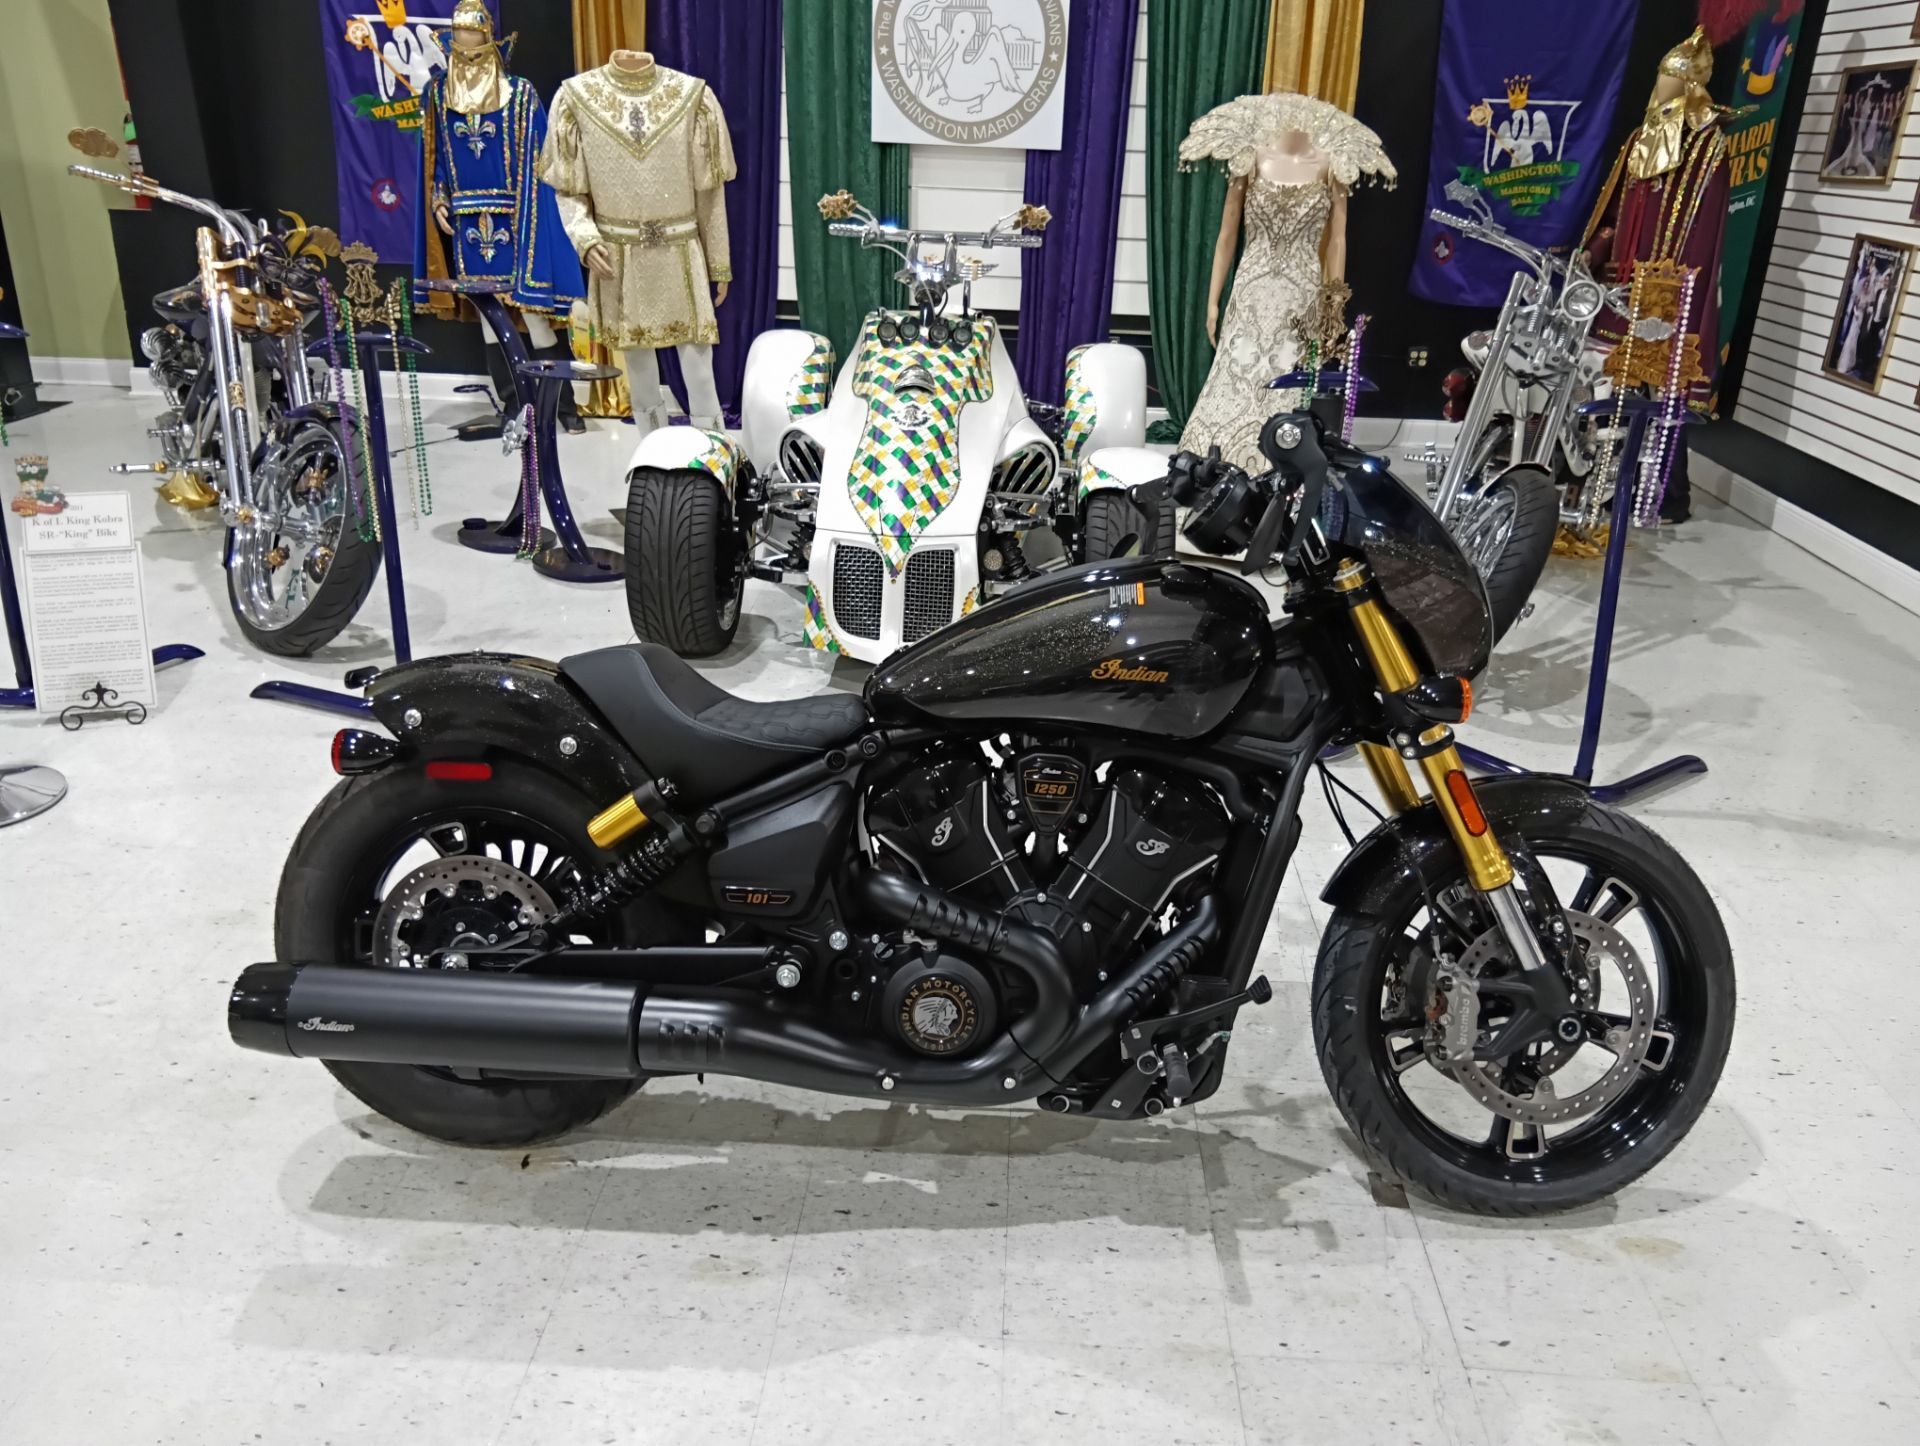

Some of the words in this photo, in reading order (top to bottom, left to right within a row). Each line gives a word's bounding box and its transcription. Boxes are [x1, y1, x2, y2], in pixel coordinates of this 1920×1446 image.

[877, 11, 892, 40] The
[881, 60, 968, 140] WASHINGTON
[972, 112, 1024, 140] MARDI
[1023, 67, 1056, 113] GRAS
[1483, 163, 1562, 186] WASHINGTON
[1728, 146, 1771, 187] RAS
[1500, 186, 1527, 195] MARDI
[1529, 186, 1551, 194] GRAS
[32, 517, 41, 527] K
[43, 518, 53, 526] of
[66, 515, 91, 526] King
[93, 514, 123, 524] Kobra
[96, 528, 118, 537] Bike
[1091, 659, 1169, 683] Indian
[1034, 783, 1068, 795] 1250
[746, 893, 769, 904] 101
[902, 987, 920, 1036] INDIAN
[922, 980, 976, 1041] MOTORCYCLE
[1456, 998, 1470, 1046] brembo
[303, 1016, 349, 1032] Indian
